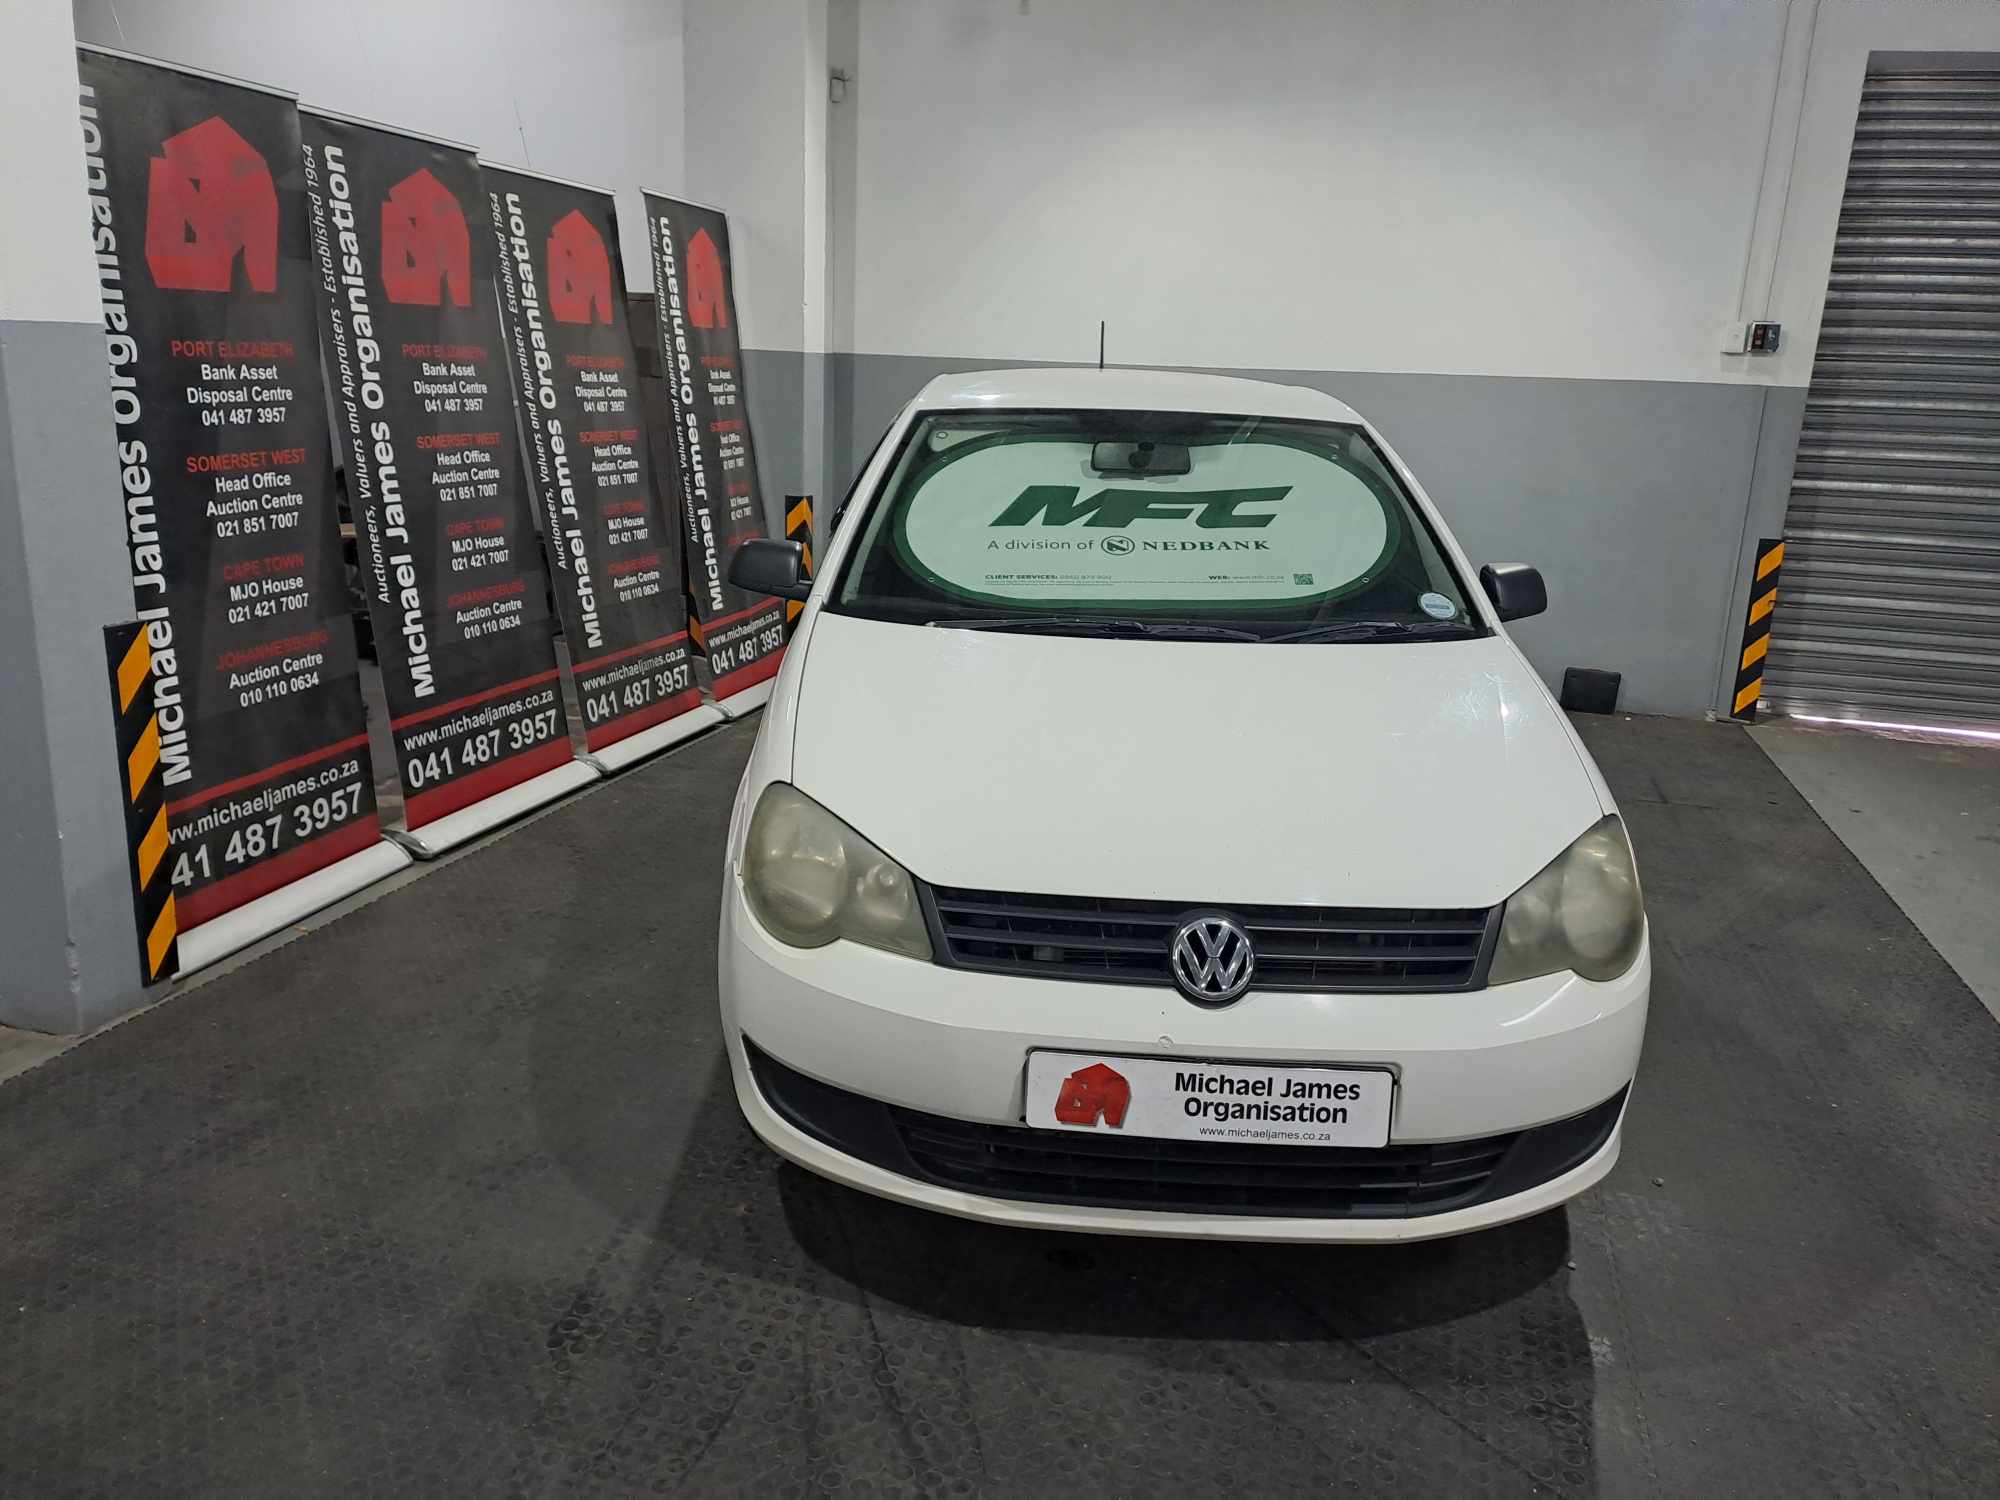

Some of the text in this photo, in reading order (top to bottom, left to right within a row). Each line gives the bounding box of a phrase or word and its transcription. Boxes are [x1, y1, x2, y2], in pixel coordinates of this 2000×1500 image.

[302, 144, 319, 188] 1964
[307, 191, 337, 293] Established
[171, 340, 214, 357] PORT
[331, 308, 355, 398] Appraisers
[201, 364, 278, 380] Bank Asset
[422, 363, 475, 376] Bank Asset
[186, 386, 293, 406] Disposal Centre
[414, 381, 487, 396] Disposal Centre
[202, 407, 286, 426] 041 487 3957
[344, 400, 361, 434] and
[425, 398, 483, 412] 041 487 3957
[526, 402, 540, 430] and
[660, 216, 724, 611] Michael James Organisation
[324, 145, 435, 698] Michael James Organisation
[506, 193, 603, 649] Michael James Organisation
[186, 448, 306, 473] SOMERSET WEST
[353, 438, 372, 498] Valuers
[437, 451, 490, 466] Head Office
[534, 433, 550, 483] Valuers
[215, 472, 292, 493] Head Office
[432, 468, 499, 485] Auction Centre
[206, 492, 303, 517] Auction Centre
[440, 484, 497, 501] 021 851 7007
[988, 485, 1293, 529] MFC
[118, 440, 166, 594] James
[216, 512, 299, 537] 021 851 7007
[365, 505, 391, 603] Auctioneers,
[452, 536, 504, 553] MJO House
[987, 539, 999, 550] A
[1005, 539, 1071, 550] division
[1077, 539, 1095, 550] of
[1142, 540, 1270, 551] NEDBANK
[452, 550, 509, 571] 021 421 7007
[230, 577, 303, 601] MJO House
[228, 593, 309, 624] 021 421 7007
[457, 600, 522, 624] Auction Centre
[464, 626, 480, 639] 010
[482, 620, 497, 633] 110
[712, 624, 783, 674] 041 487 3957
[229, 653, 323, 689] Auction Centre
[582, 648, 686, 692] www.michaeljames.co.za
[137, 607, 192, 787] Michael
[239, 672, 319, 708] 010 110 0634
[587, 664, 688, 723] 041 487 3957
[404, 690, 553, 750] www.michaeljames.co.za
[408, 709, 556, 788] 041 487 3957
[168, 759, 359, 845] w.michaeljames.co.za
[170, 782, 362, 887] 41 487 3957
[1174, 1072, 1361, 1101] Michael James
[1183, 1097, 1349, 1124] Organisation
[1199, 1127, 1331, 1142] www.michaeljames.co.za
